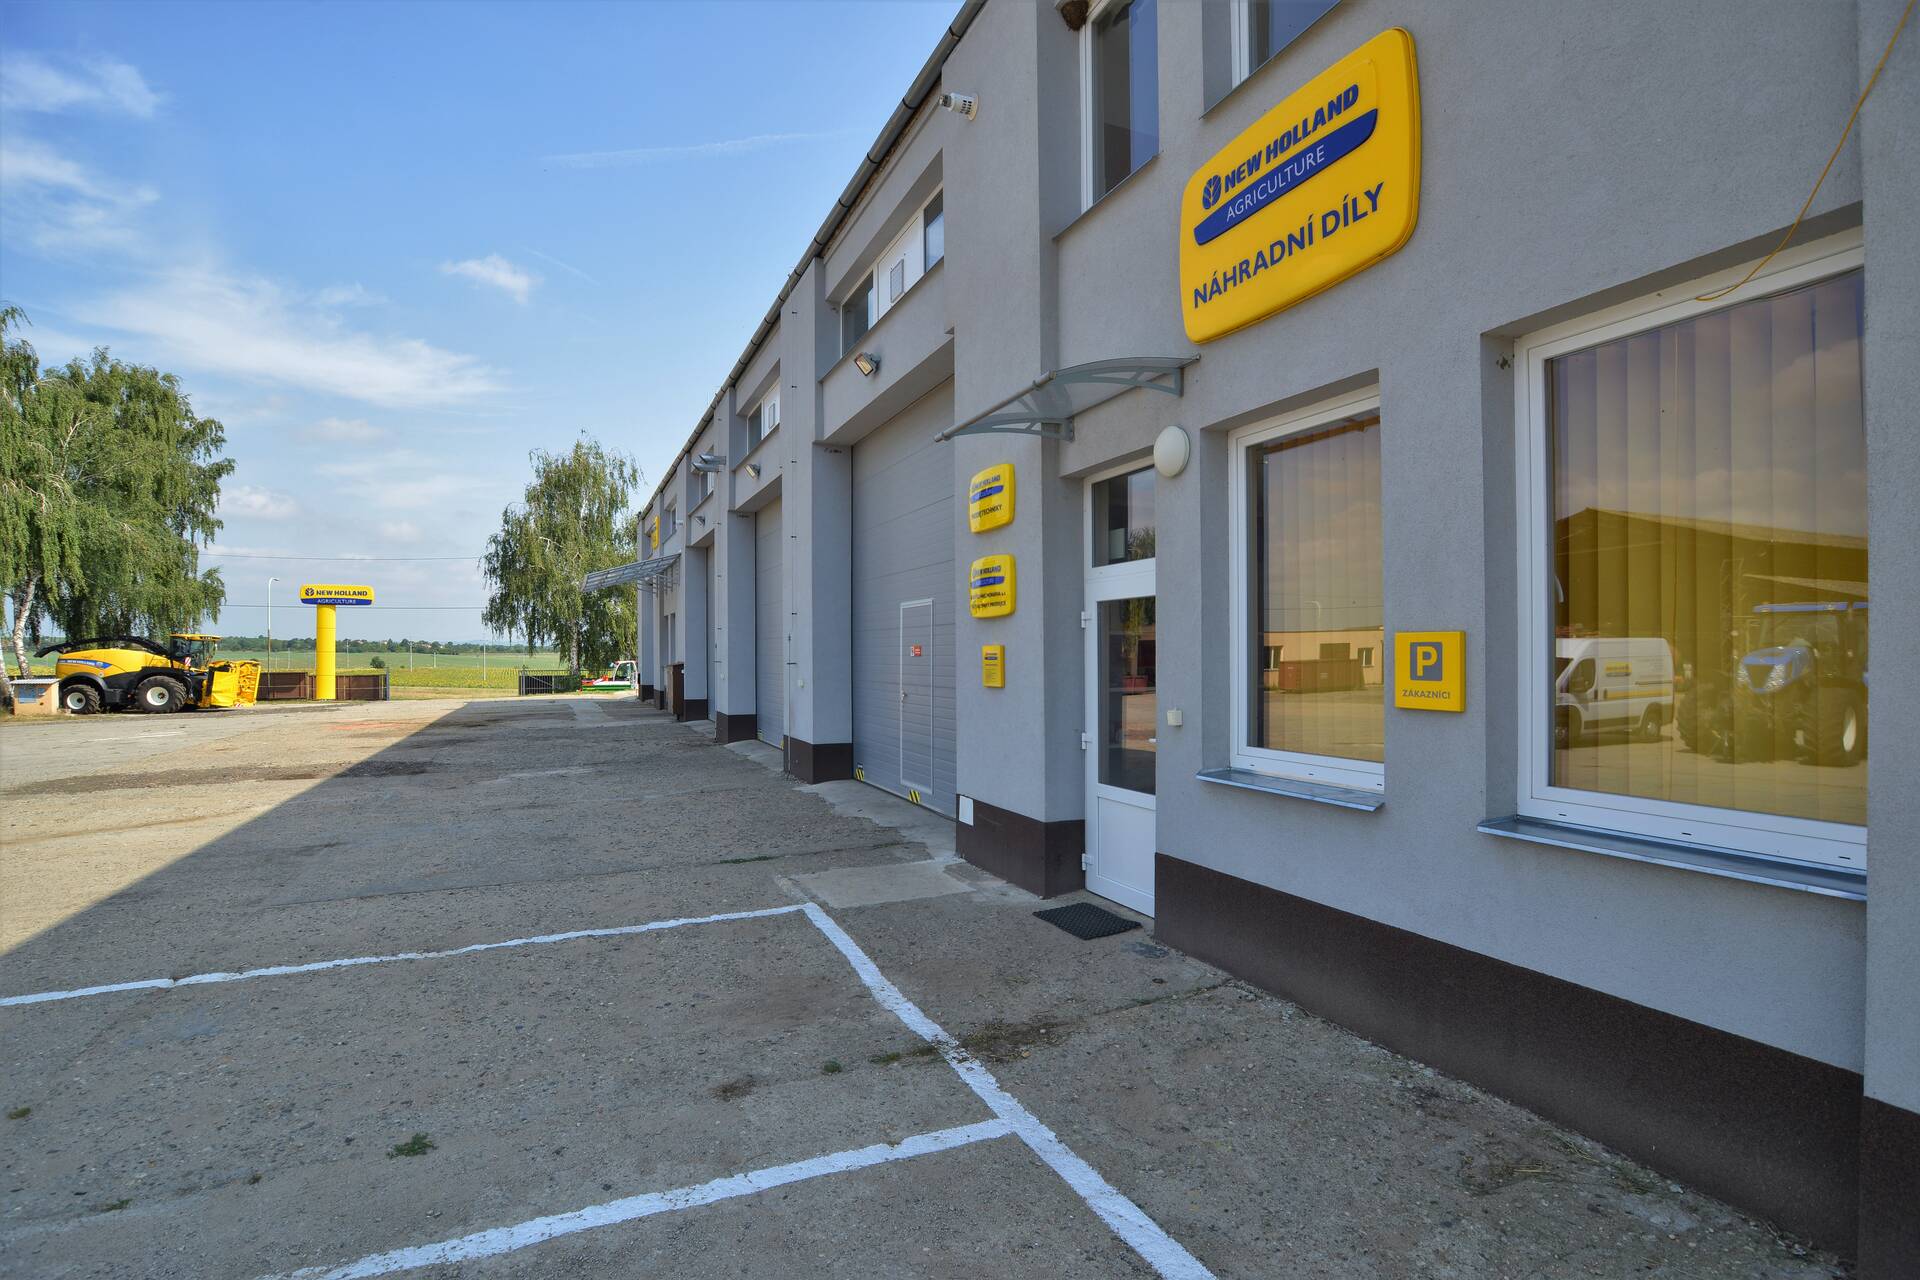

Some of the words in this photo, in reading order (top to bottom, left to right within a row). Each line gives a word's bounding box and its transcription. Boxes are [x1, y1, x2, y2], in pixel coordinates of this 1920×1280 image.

[1224, 150, 1263, 193] NEW
[1265, 83, 1359, 165] HOLLAND
[1226, 144, 1326, 223] AGRICULTURE
[1193, 214, 1314, 309] NÁHRADNÍ
[1321, 181, 1384, 239] DÍLY
[1416, 645, 1438, 677] P
